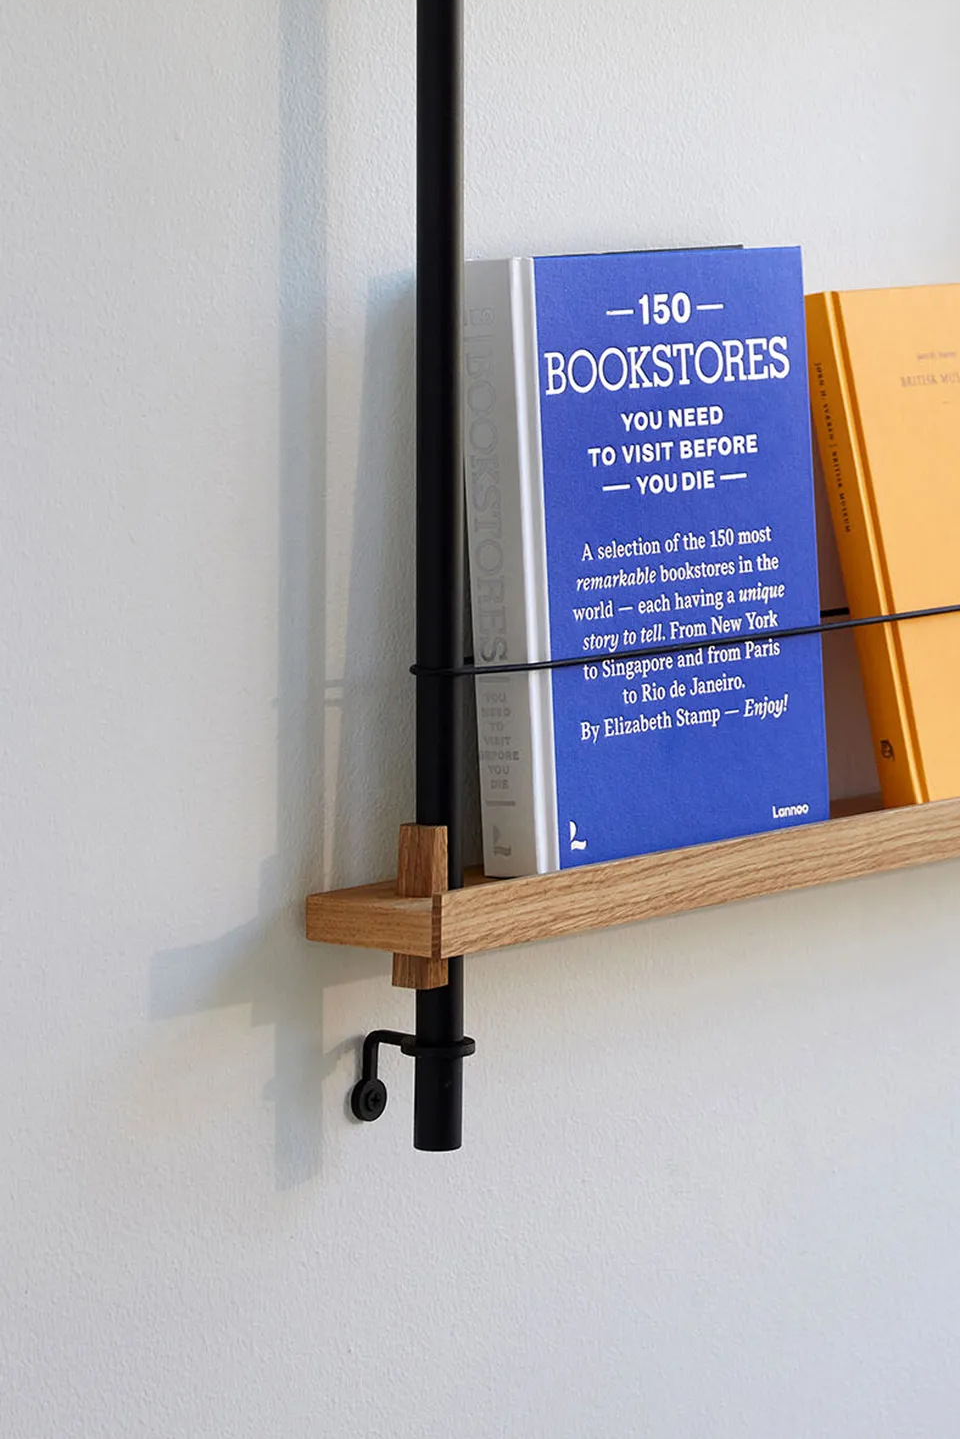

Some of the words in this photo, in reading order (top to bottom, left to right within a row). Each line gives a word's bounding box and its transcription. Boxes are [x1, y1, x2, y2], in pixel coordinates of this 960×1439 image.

[639, 292, 691, 325] 150
[544, 336, 790, 396] BOOKSTORES
[621, 411, 663, 432] YOU
[668, 405, 724, 429] NEED
[588, 446, 616, 467] TO
[622, 441, 674, 464] VISIT
[680, 434, 758, 459] BEFORE
[636, 474, 678, 495] YOU
[682, 470, 715, 491] DIE
[581, 543, 594, 562] A
[598, 536, 661, 560] selection
[665, 533, 681, 553] of
[683, 532, 706, 551] the
[709, 528, 735, 548] 150
[738, 526, 772, 545] most
[576, 567, 657, 592] remarkable
[660, 561, 735, 583] bookstores
[738, 556, 753, 574] in
[756, 553, 779, 572] the
[573, 600, 614, 622] world
[637, 594, 671, 615] each
[674, 589, 724, 611] having
[727, 591, 736, 604] a
[738, 582, 786, 605] unique
[582, 632, 619, 653] story
[622, 629, 637, 645] to
[640, 624, 666, 643] tell.
[670, 622, 708, 640] From
[711, 616, 743, 635] New
[745, 610, 778, 630] York
[582, 664, 598, 681] to
[602, 655, 674, 680] Singapore
[677, 648, 704, 668] and
[708, 645, 742, 665] from
[745, 639, 781, 660] Paris
[622, 689, 638, 705] to
[642, 683, 666, 703] Rio
[669, 680, 687, 698] de
[690, 673, 746, 696] Janeiro.
[581, 721, 600, 744] By
[604, 710, 673, 737] Elizabeth
[676, 707, 721, 728] Stamp
[744, 694, 789, 719] Enjoy!
[772, 803, 809, 819] Lannoo
